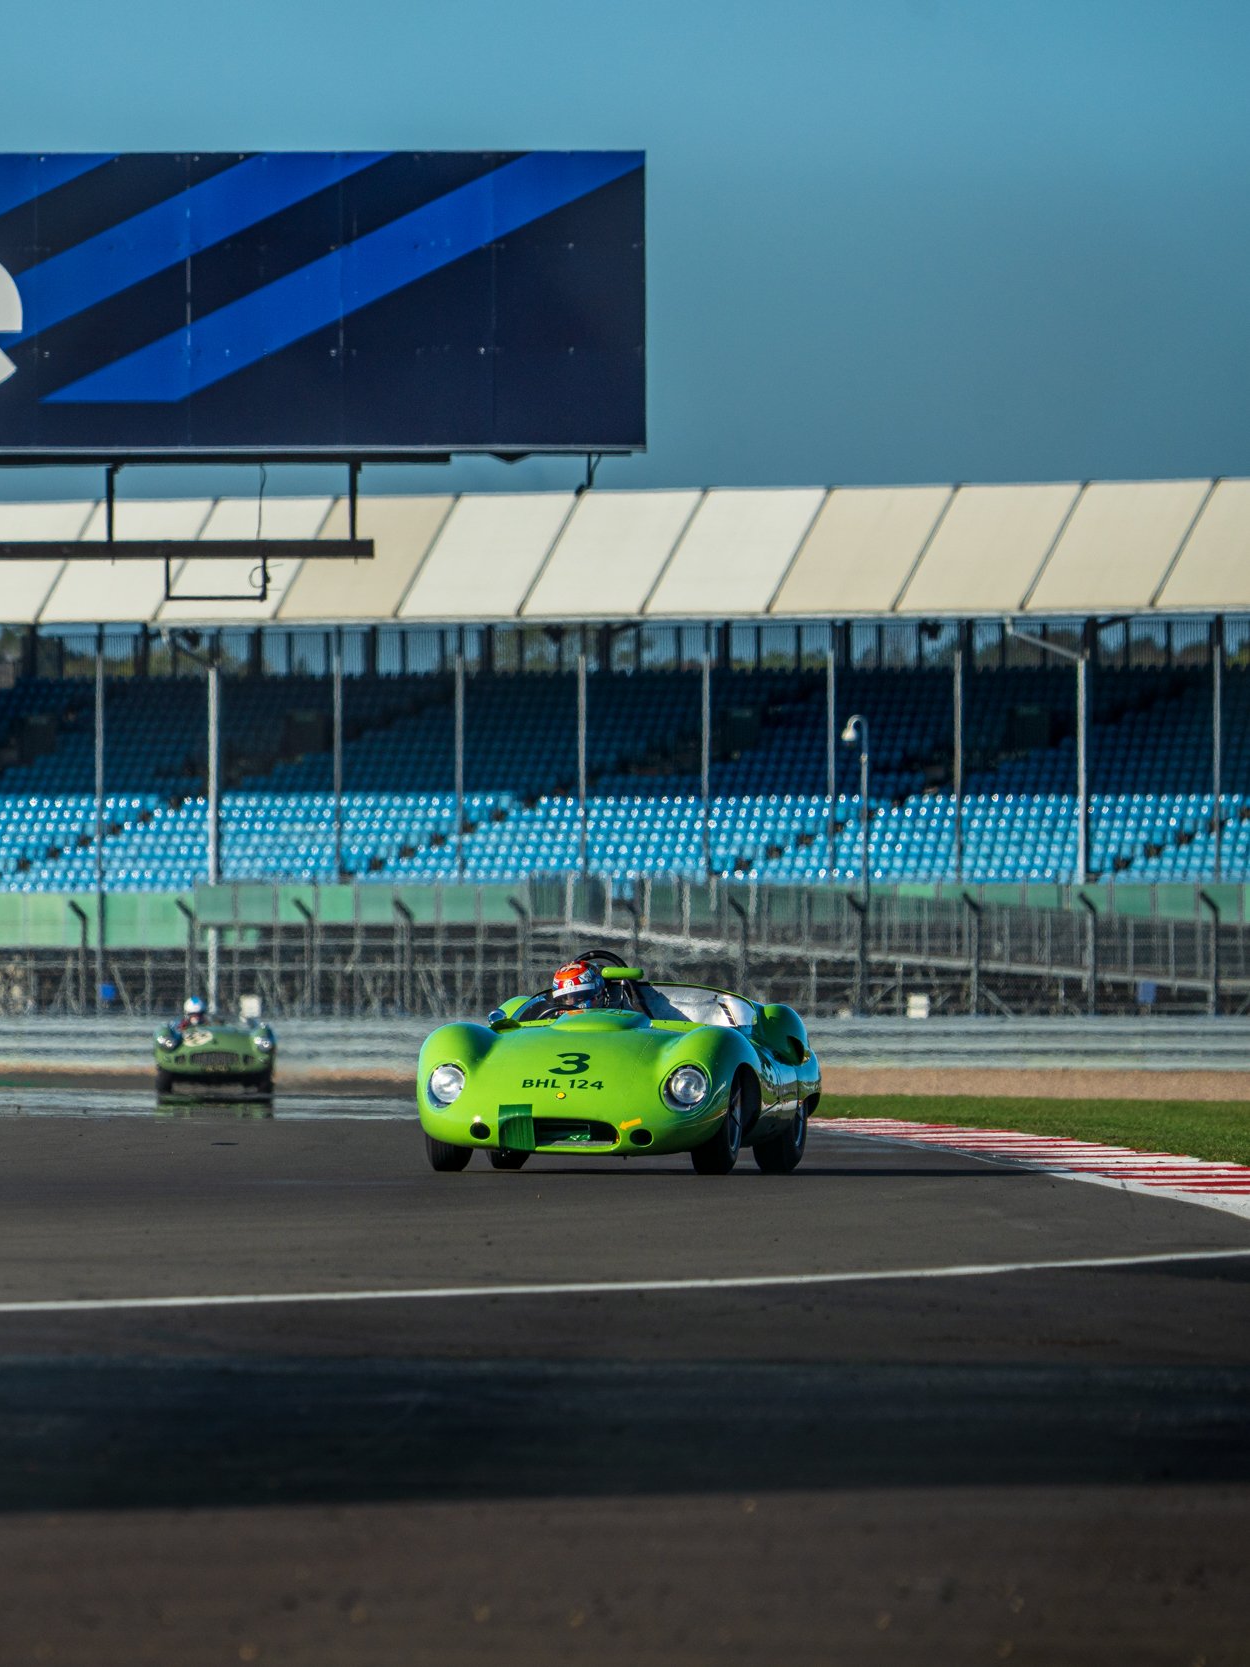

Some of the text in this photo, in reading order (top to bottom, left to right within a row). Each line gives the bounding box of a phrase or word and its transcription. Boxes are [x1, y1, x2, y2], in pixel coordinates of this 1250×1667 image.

[548, 1053, 590, 1075] 3
[522, 1079, 604, 1090] BHL 124
